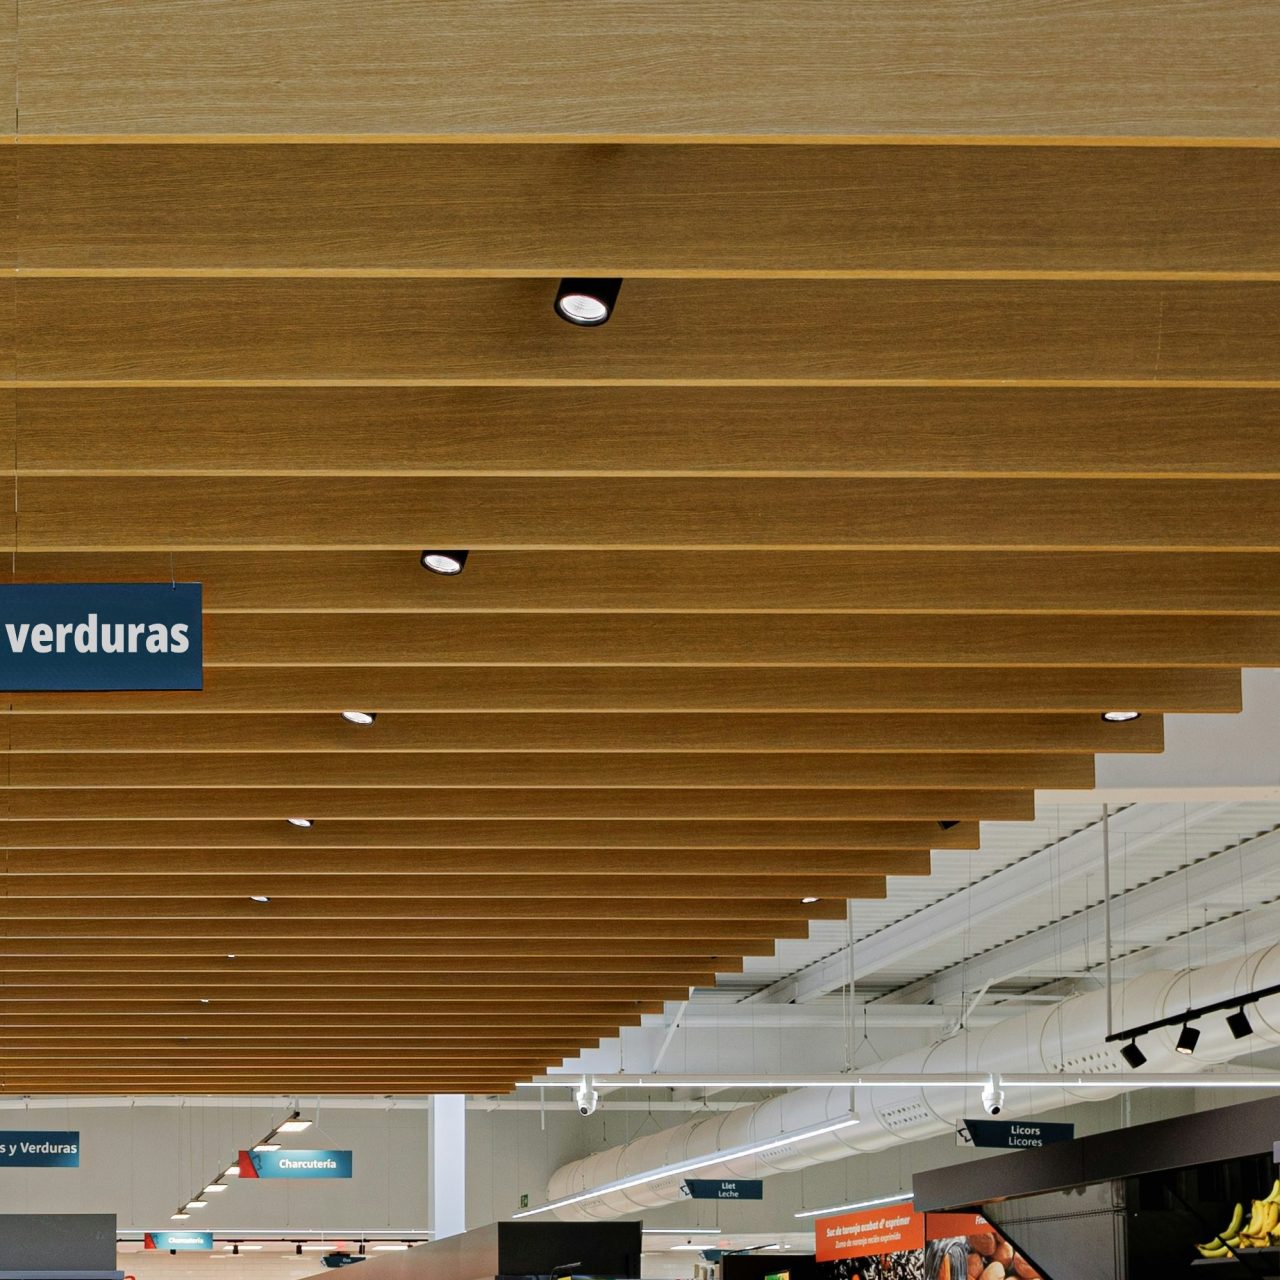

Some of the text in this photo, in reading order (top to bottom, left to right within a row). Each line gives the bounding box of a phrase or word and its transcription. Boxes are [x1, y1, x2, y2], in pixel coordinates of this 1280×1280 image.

[4, 613, 190, 654] verduras
[1011, 1125, 1041, 1135] Licors
[1008, 1136, 1043, 1147] Licores
[9, 1144, 17, 1156] y
[20, 1141, 78, 1154] Verduras
[279, 1158, 337, 1169] Charcutería
[721, 1182, 736, 1190] Llet
[718, 1190, 739, 1198] Leche
